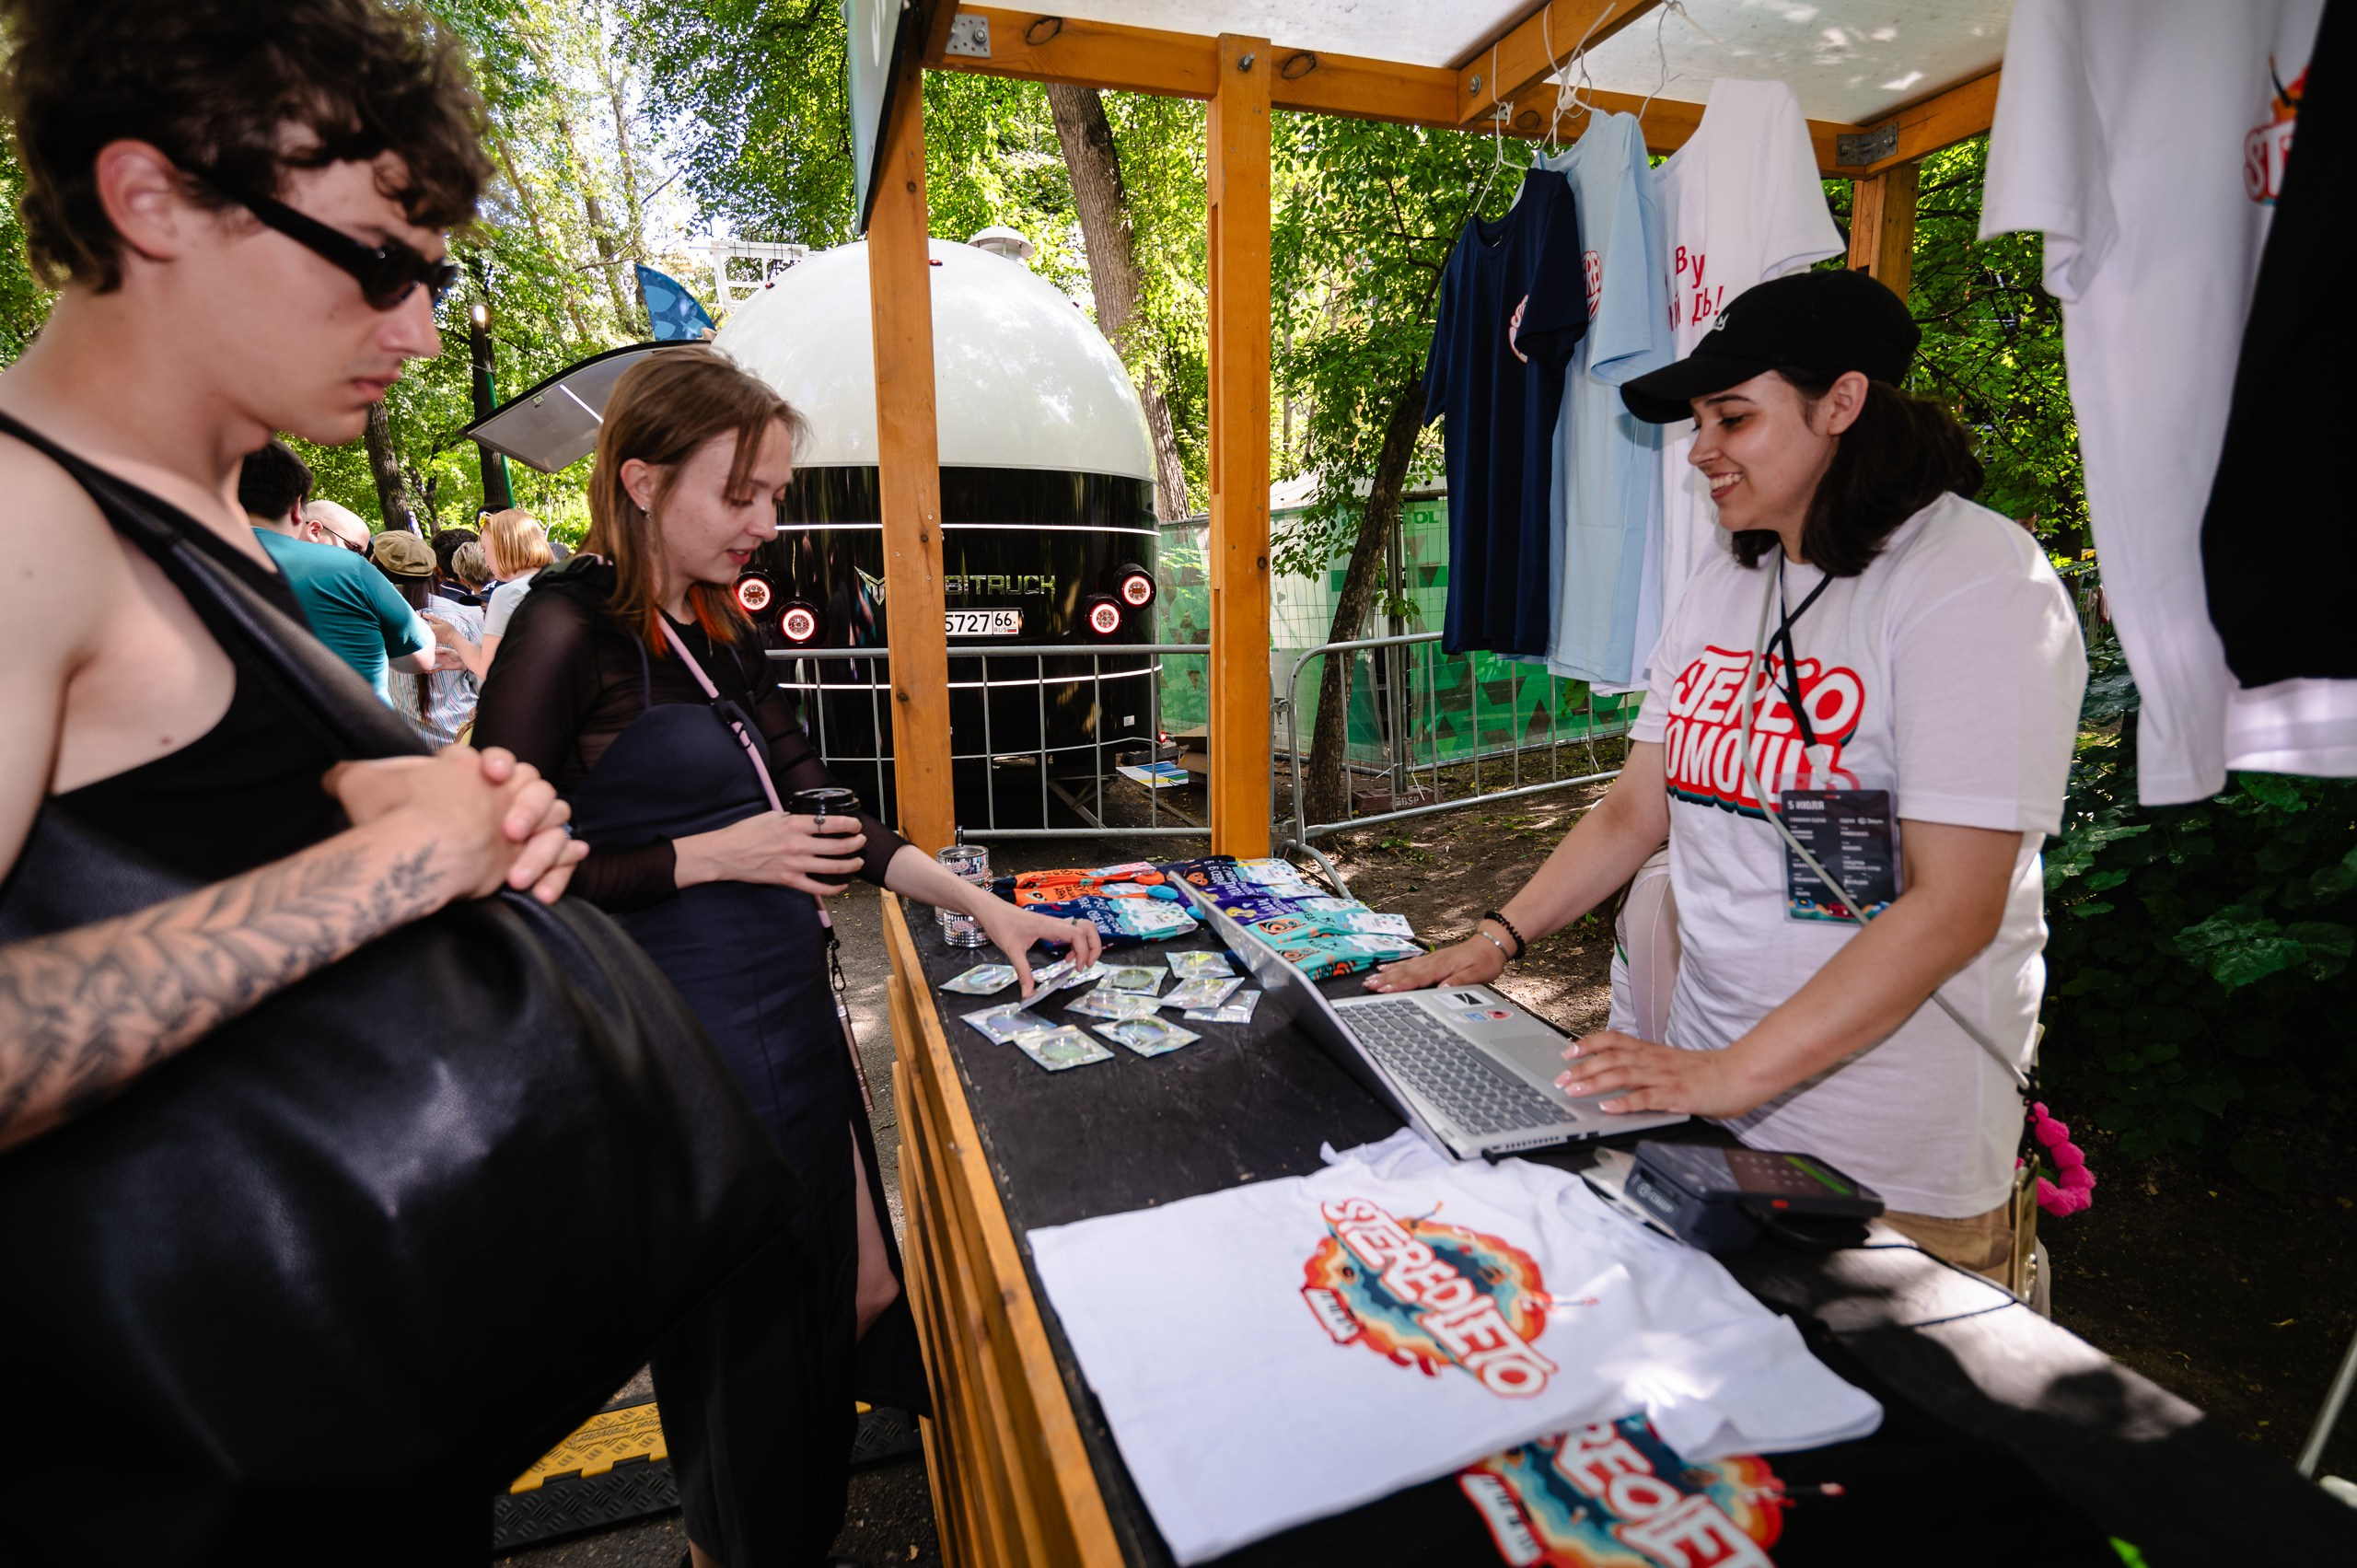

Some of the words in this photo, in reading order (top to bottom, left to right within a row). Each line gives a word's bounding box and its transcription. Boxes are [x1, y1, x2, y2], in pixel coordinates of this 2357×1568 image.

[945, 575, 1056, 595] BITRUCK
[994, 612, 1012, 626] 66
[1787, 800, 1794, 810] 5
